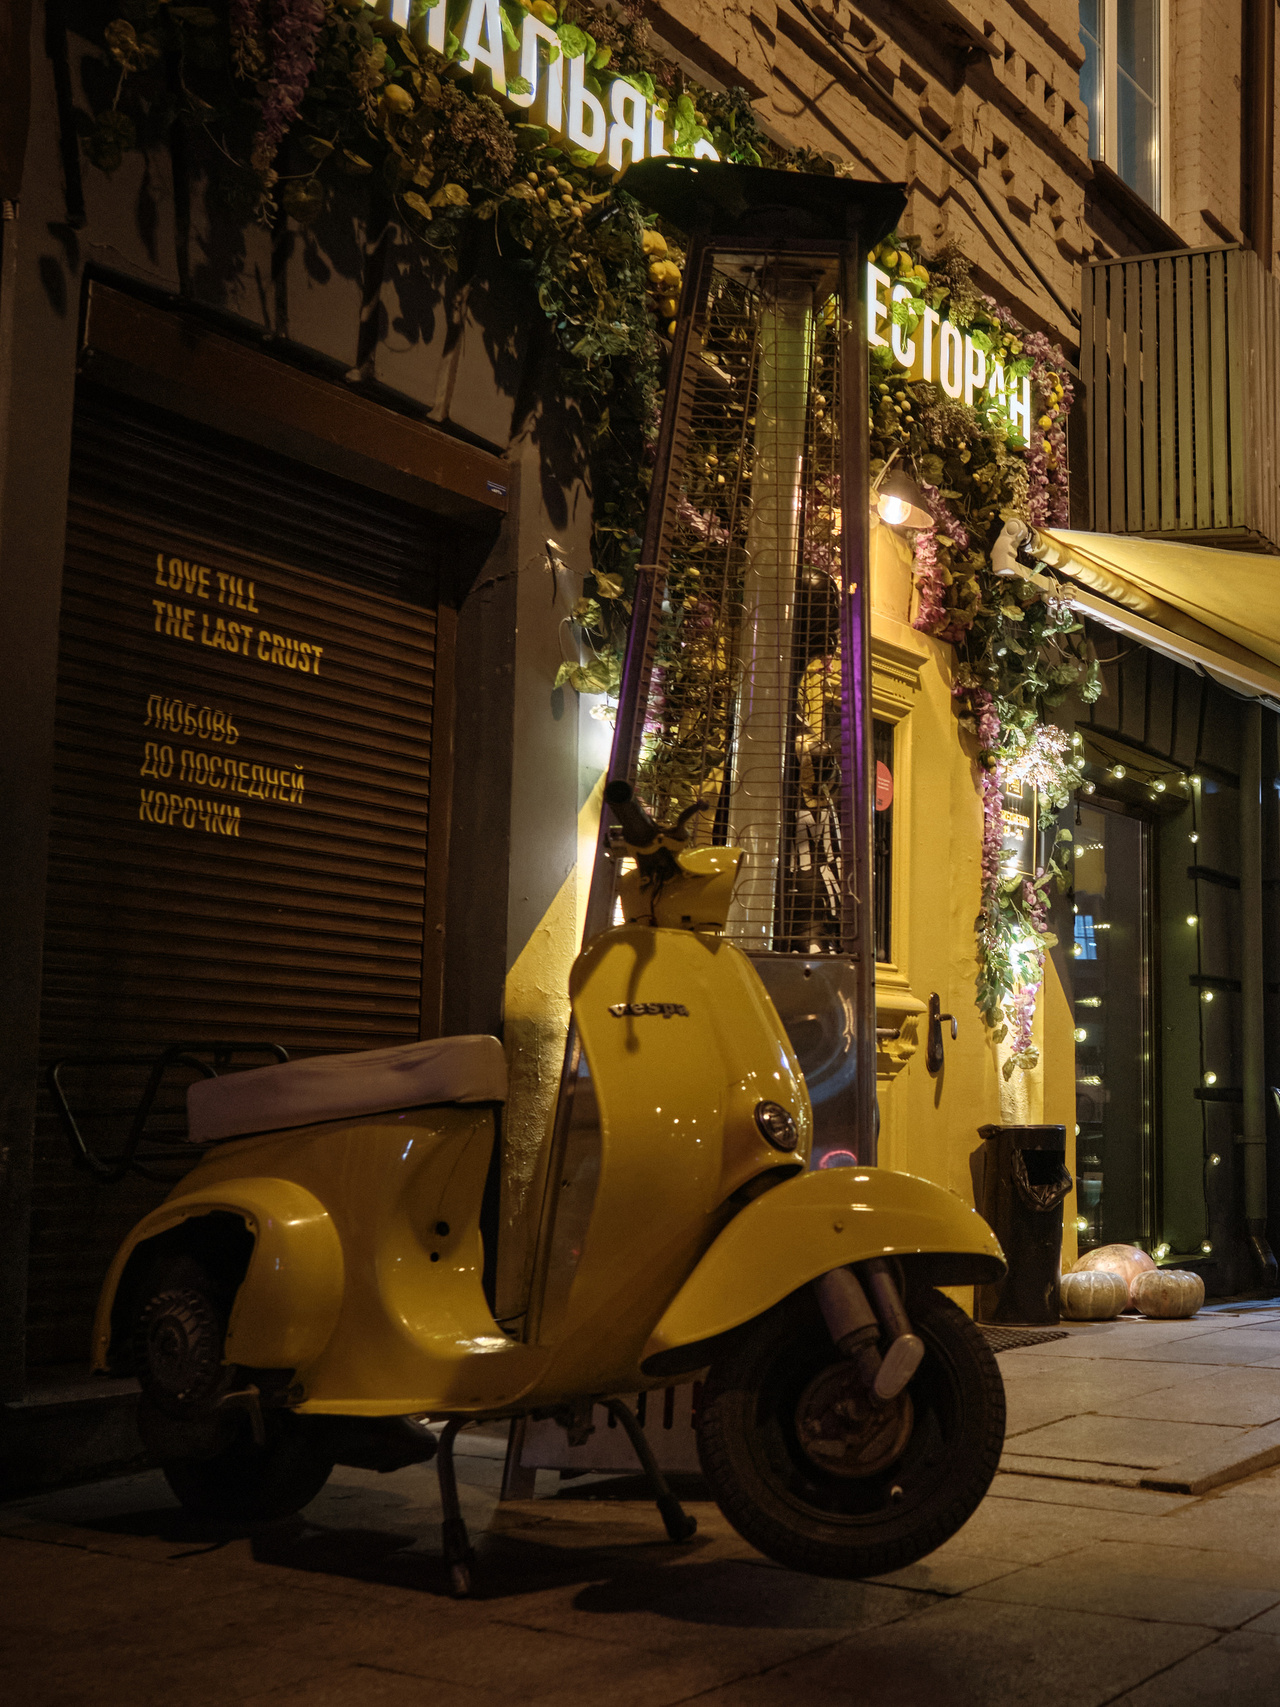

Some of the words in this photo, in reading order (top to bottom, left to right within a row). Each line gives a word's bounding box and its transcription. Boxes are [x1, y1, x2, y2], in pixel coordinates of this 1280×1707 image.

[155, 553, 211, 599] LOVE
[216, 572, 259, 613] TILL
[152, 600, 196, 641] THE
[201, 614, 253, 656] LAST
[257, 630, 324, 675] CRUST
[144, 694, 240, 745] ЛЮБОВЬ
[140, 741, 174, 779] ДО
[179, 749, 305, 804] ПОСЛЕДНЕЙ
[139, 788, 242, 837] КОРОЧКИ
